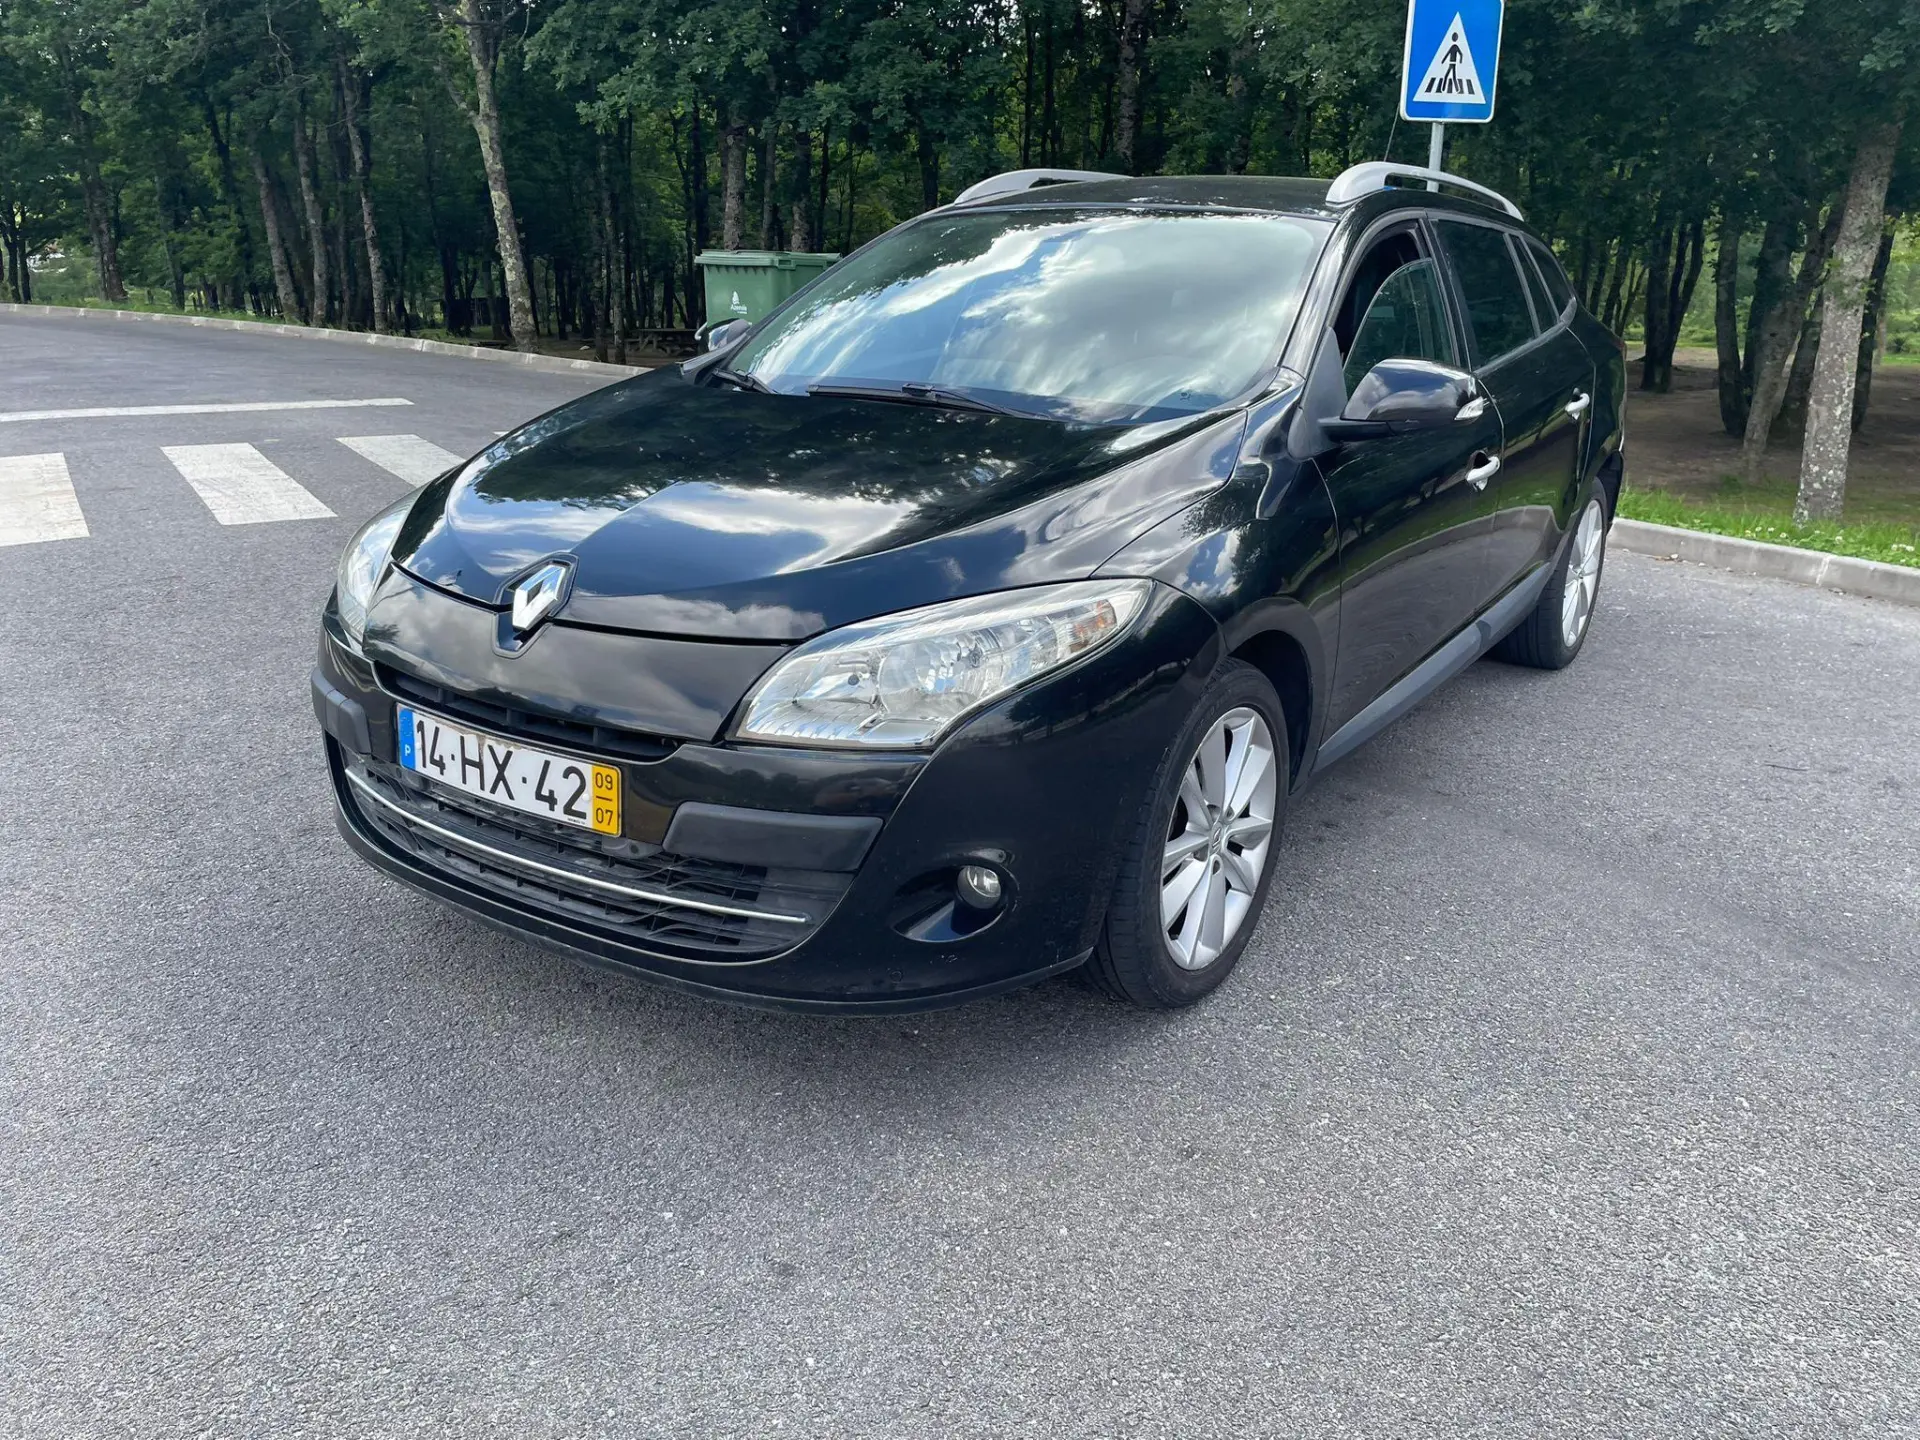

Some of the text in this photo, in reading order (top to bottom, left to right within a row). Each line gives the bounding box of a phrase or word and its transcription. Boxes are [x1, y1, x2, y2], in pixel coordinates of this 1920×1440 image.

[404, 744, 411, 756] P
[595, 772, 613, 790] 09
[595, 807, 613, 826] 07
